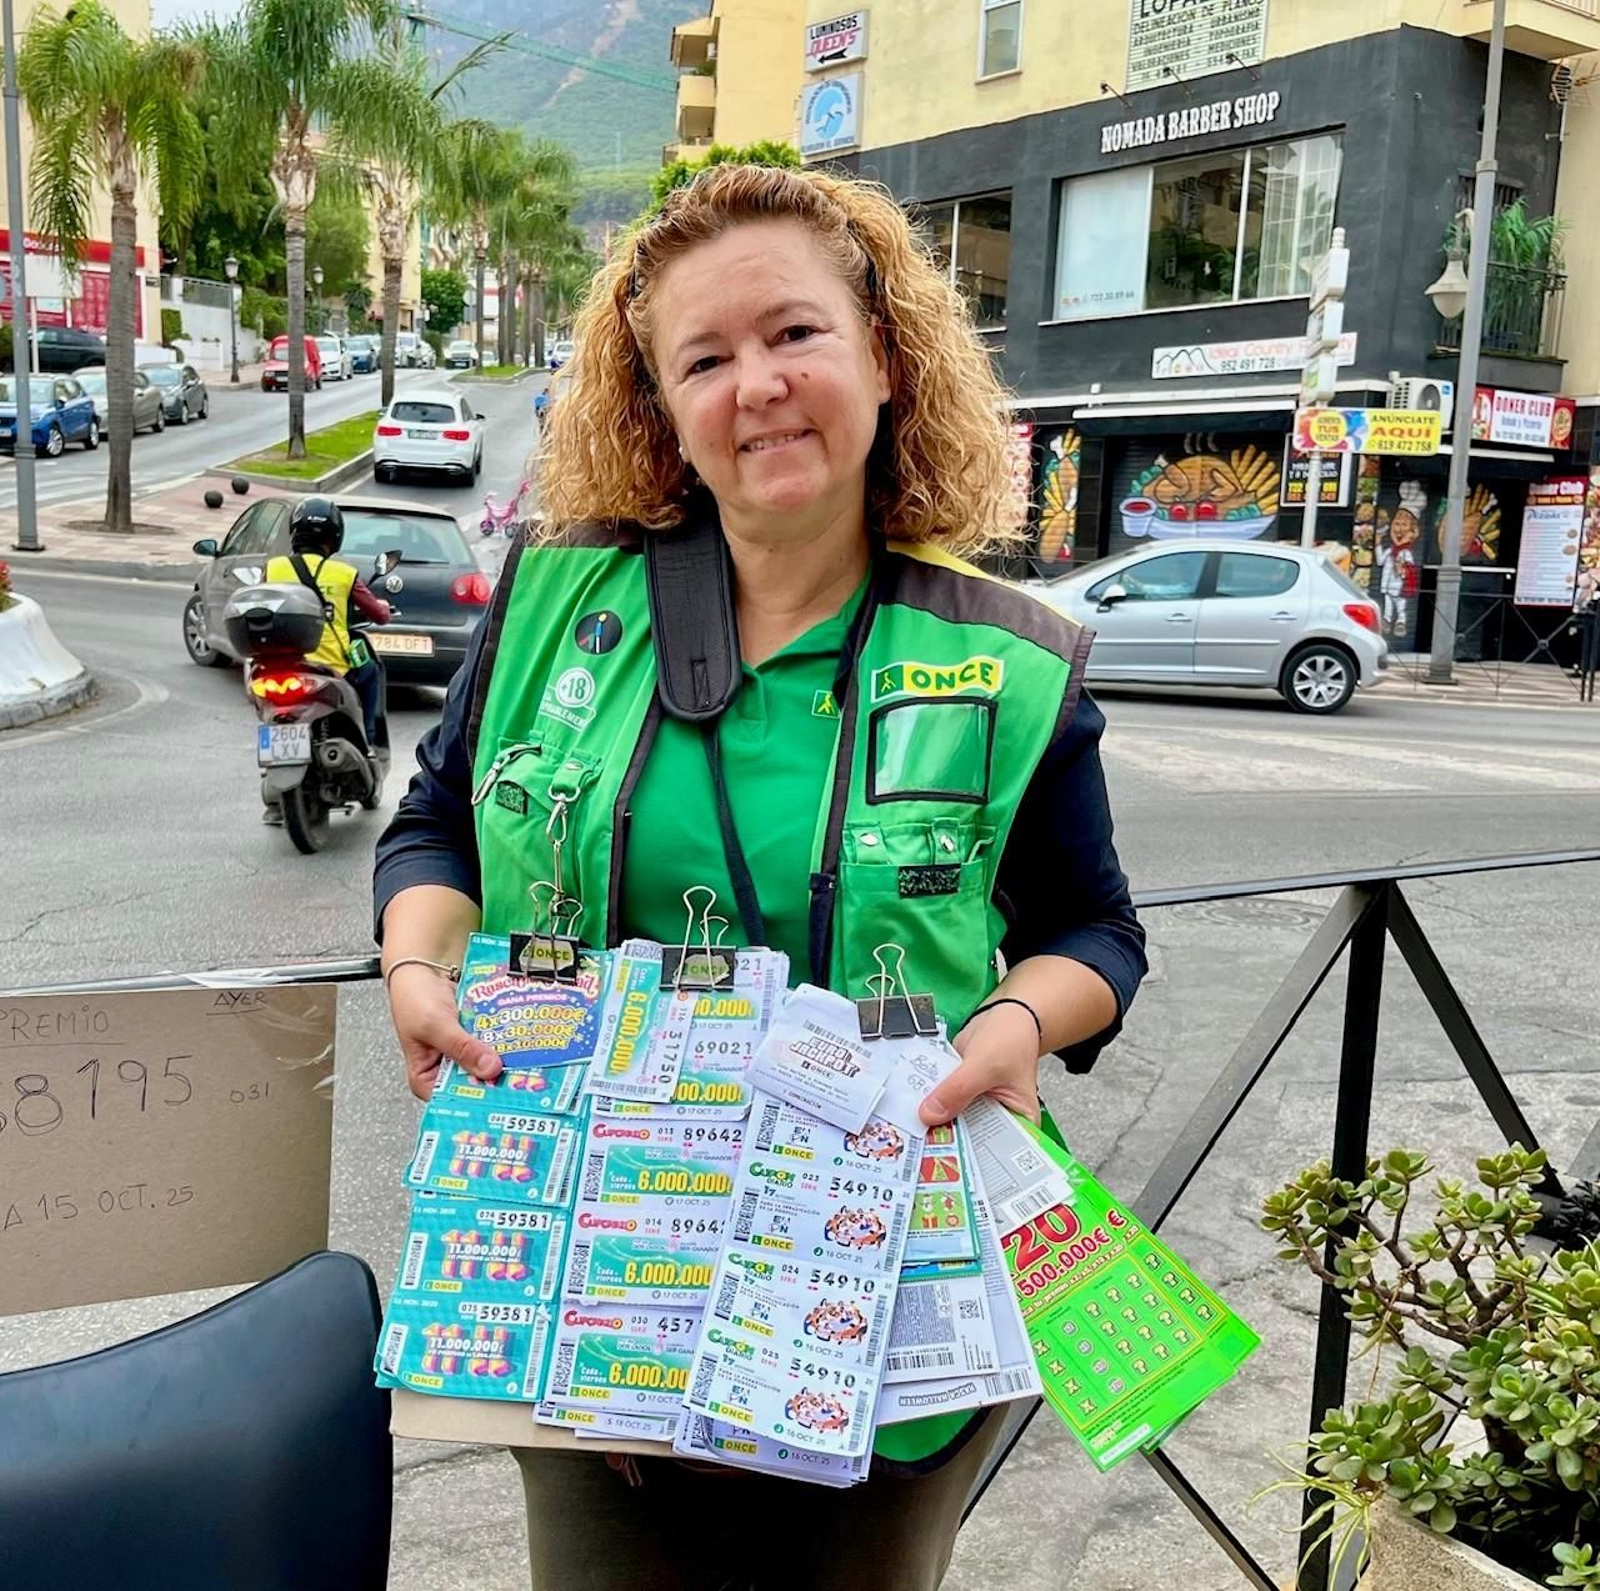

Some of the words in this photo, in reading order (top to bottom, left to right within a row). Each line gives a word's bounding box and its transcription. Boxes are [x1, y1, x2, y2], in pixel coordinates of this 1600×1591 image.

[810, 15, 858, 39] LUMINOSOS
[1134, 22, 1193, 47] ARQUITECTURA
[1210, 6, 1260, 29] URBANISMO
[1208, 34, 1256, 53] MEDICIONES
[1101, 114, 1166, 153] NOMADA
[1167, 101, 1232, 141] BARBER
[1233, 90, 1281, 129] SHOP
[1220, 360, 1237, 372] 952
[1240, 358, 1256, 370] 491
[1260, 357, 1276, 369] 728
[1529, 400, 1551, 416] CLUB
[1317, 424, 1340, 434] TUS
[1397, 440, 1413, 451] 472
[374, 636, 400, 649] 784
[404, 638, 428, 651] DFT
[910, 662, 994, 691] ONCE
[560, 677, 588, 701] +18
[271, 716, 306, 742] 2604
[536, 947, 570, 960] ONCE
[213, 990, 268, 1007] AYER
[694, 1040, 752, 1055] 69021
[807, 1036, 854, 1062] EURO
[658, 1030, 683, 1085] 31750
[789, 1040, 861, 1078] JACKPOT
[810, 1065, 833, 1079] ONCE
[0, 1055, 194, 1136] 8195
[229, 1082, 269, 1103] 031
[459, 1086, 483, 1097] ONCE
[625, 1106, 651, 1114] ONCE
[506, 1117, 556, 1135] 59381
[683, 1127, 743, 1143] 89642
[784, 1147, 812, 1159] ONCE
[440, 1180, 466, 1189] ONCE
[766, 1178, 794, 1188] DIARIO
[829, 1176, 894, 1202] 54910
[763, 1185, 777, 1197] 17
[37, 1194, 79, 1220] 15
[99, 1184, 157, 1213] OCT.
[167, 1185, 196, 1206] 25
[611, 1195, 637, 1204] ONCE
[496, 1212, 548, 1229] 59381
[762, 1238, 793, 1251] ONCE
[1016, 1226, 1112, 1297] 500.000€
[743, 1274, 756, 1285] 17
[745, 1269, 772, 1281] DIARIO
[781, 1263, 800, 1275] 024
[809, 1268, 875, 1294] 54910
[434, 1282, 461, 1292] ONCE
[597, 1287, 624, 1297] ONCE
[663, 1291, 672, 1299] 17
[479, 1306, 532, 1323] 59381
[657, 1316, 702, 1334] 457
[744, 1321, 773, 1336] ONCE
[725, 1346, 752, 1361] DIARIO
[805, 1342, 814, 1350] 16
[833, 1349, 844, 1358] 25
[722, 1353, 736, 1365] 17
[412, 1375, 441, 1386] ONCE
[789, 1357, 856, 1389] 54910
[581, 1388, 610, 1399] ONCE
[647, 1394, 657, 1402] 17
[898, 1390, 949, 1407] HALLOWEEN
[567, 1413, 594, 1425] ONCE
[720, 1407, 752, 1421] ONCE
[616, 1418, 624, 1427] 18
[725, 1440, 757, 1453] ONCE
[790, 1452, 800, 1460] 16
[819, 1457, 831, 1465] 25
